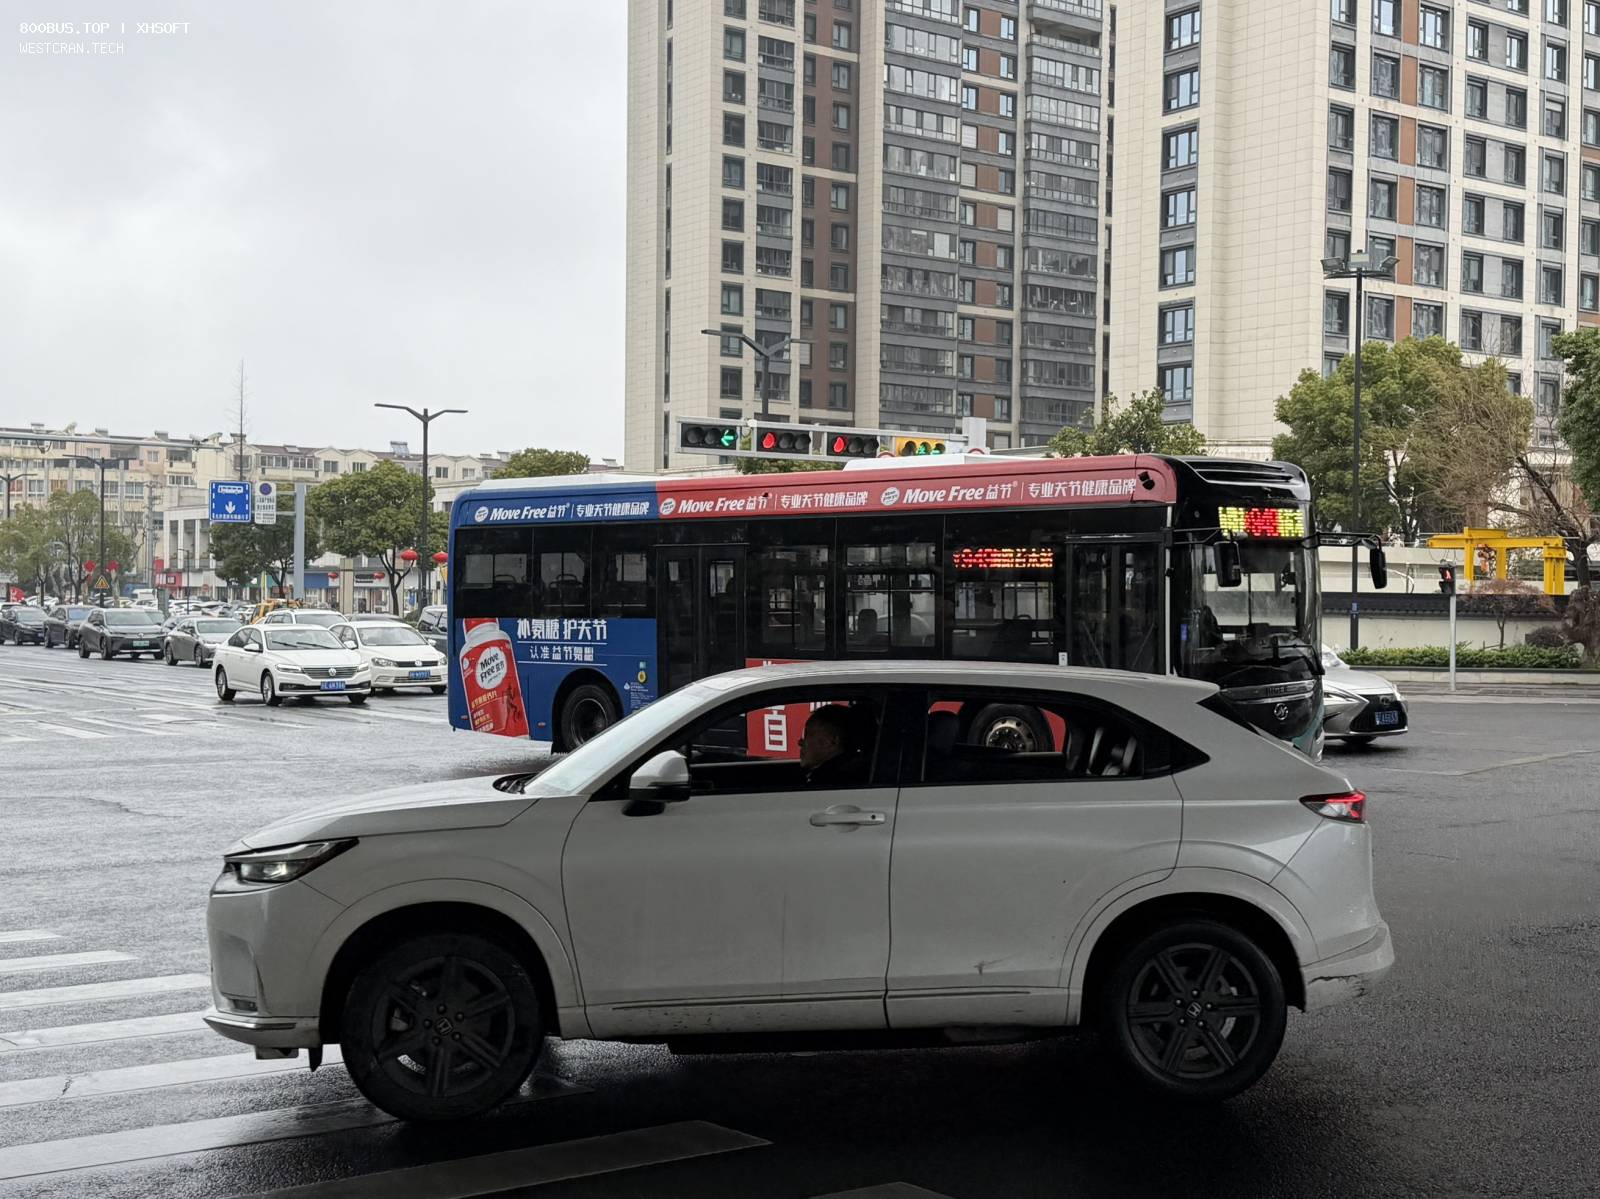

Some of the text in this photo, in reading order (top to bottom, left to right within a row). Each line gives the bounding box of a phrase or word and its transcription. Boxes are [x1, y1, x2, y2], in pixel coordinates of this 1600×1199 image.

[903, 488, 945, 504] Move
[948, 485, 983, 502] Free
[1028, 478, 1137, 498] 专业关节健康品牌
[489, 507, 520, 521] Move
[520, 505, 547, 520] Free
[678, 499, 713, 514] Move
[715, 497, 745, 512] Free
[563, 618, 608, 641] 护关节
[479, 652, 499, 672] Move
[480, 665, 495, 683] Free
